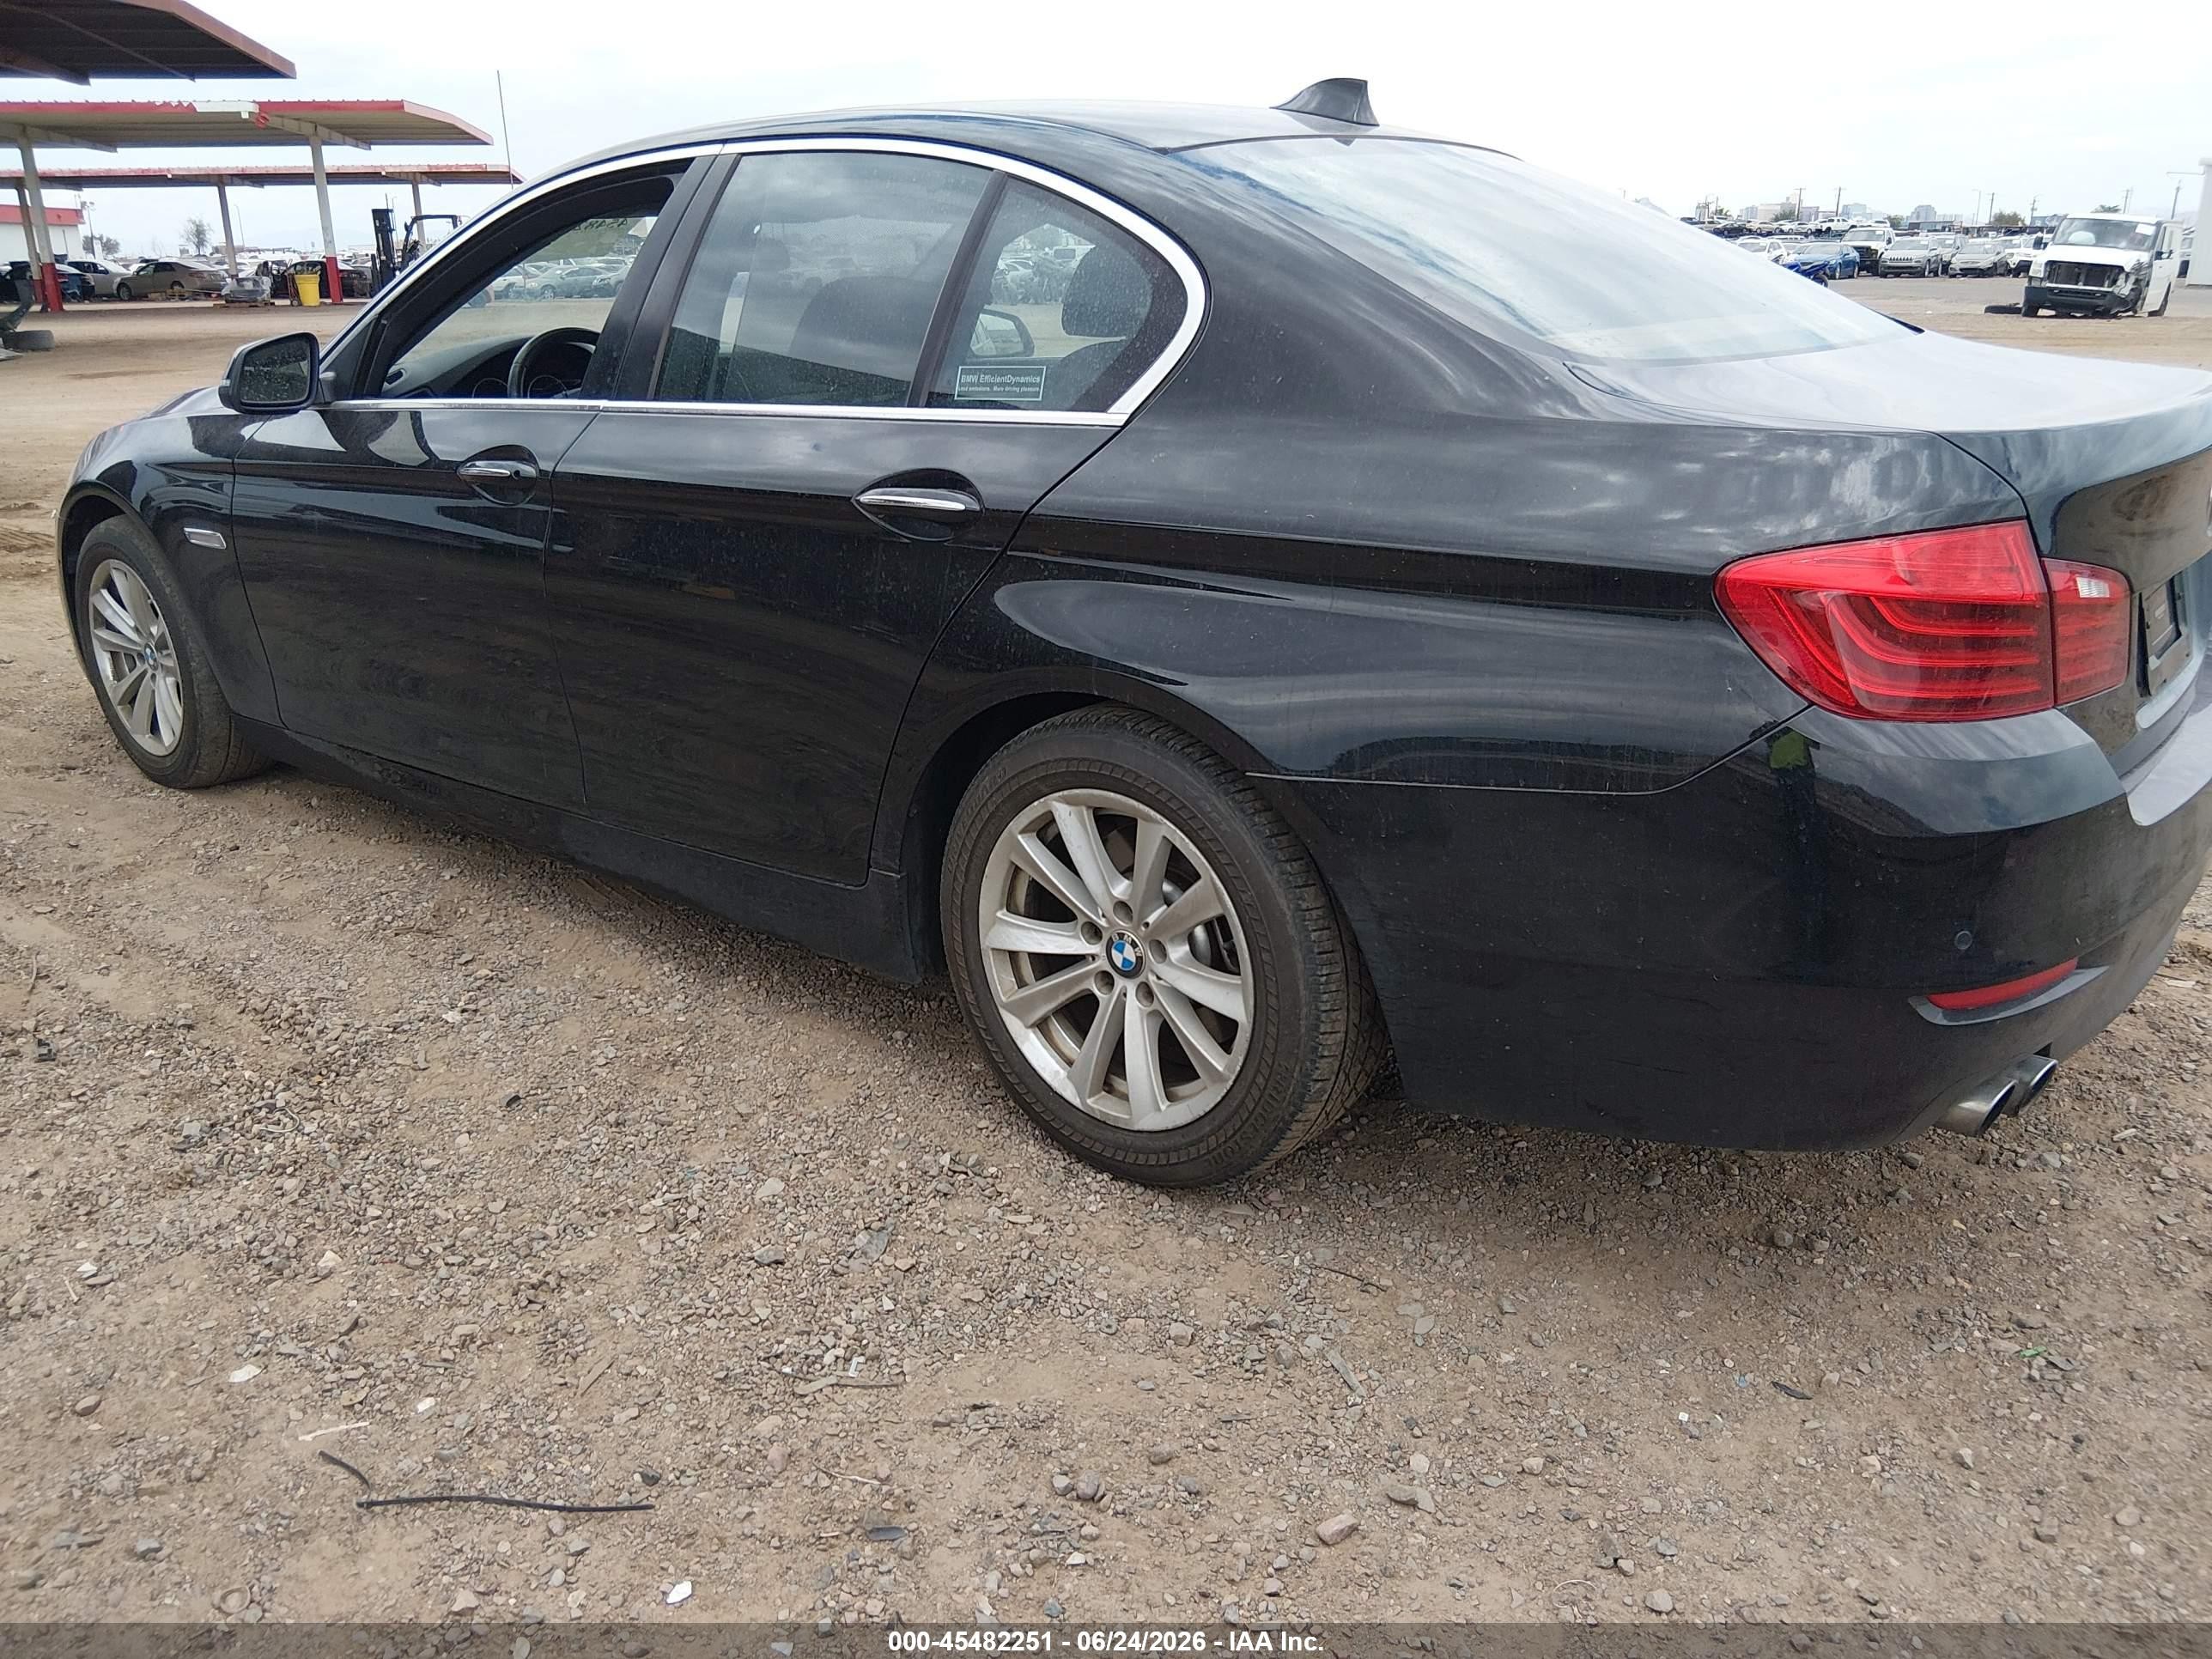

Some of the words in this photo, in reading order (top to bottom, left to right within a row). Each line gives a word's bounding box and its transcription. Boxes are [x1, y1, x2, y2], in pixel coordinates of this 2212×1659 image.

[961, 374, 978, 384] BMW
[980, 374, 1040, 385] EfficientDynamics
[1111, 933, 1143, 957] BMW
